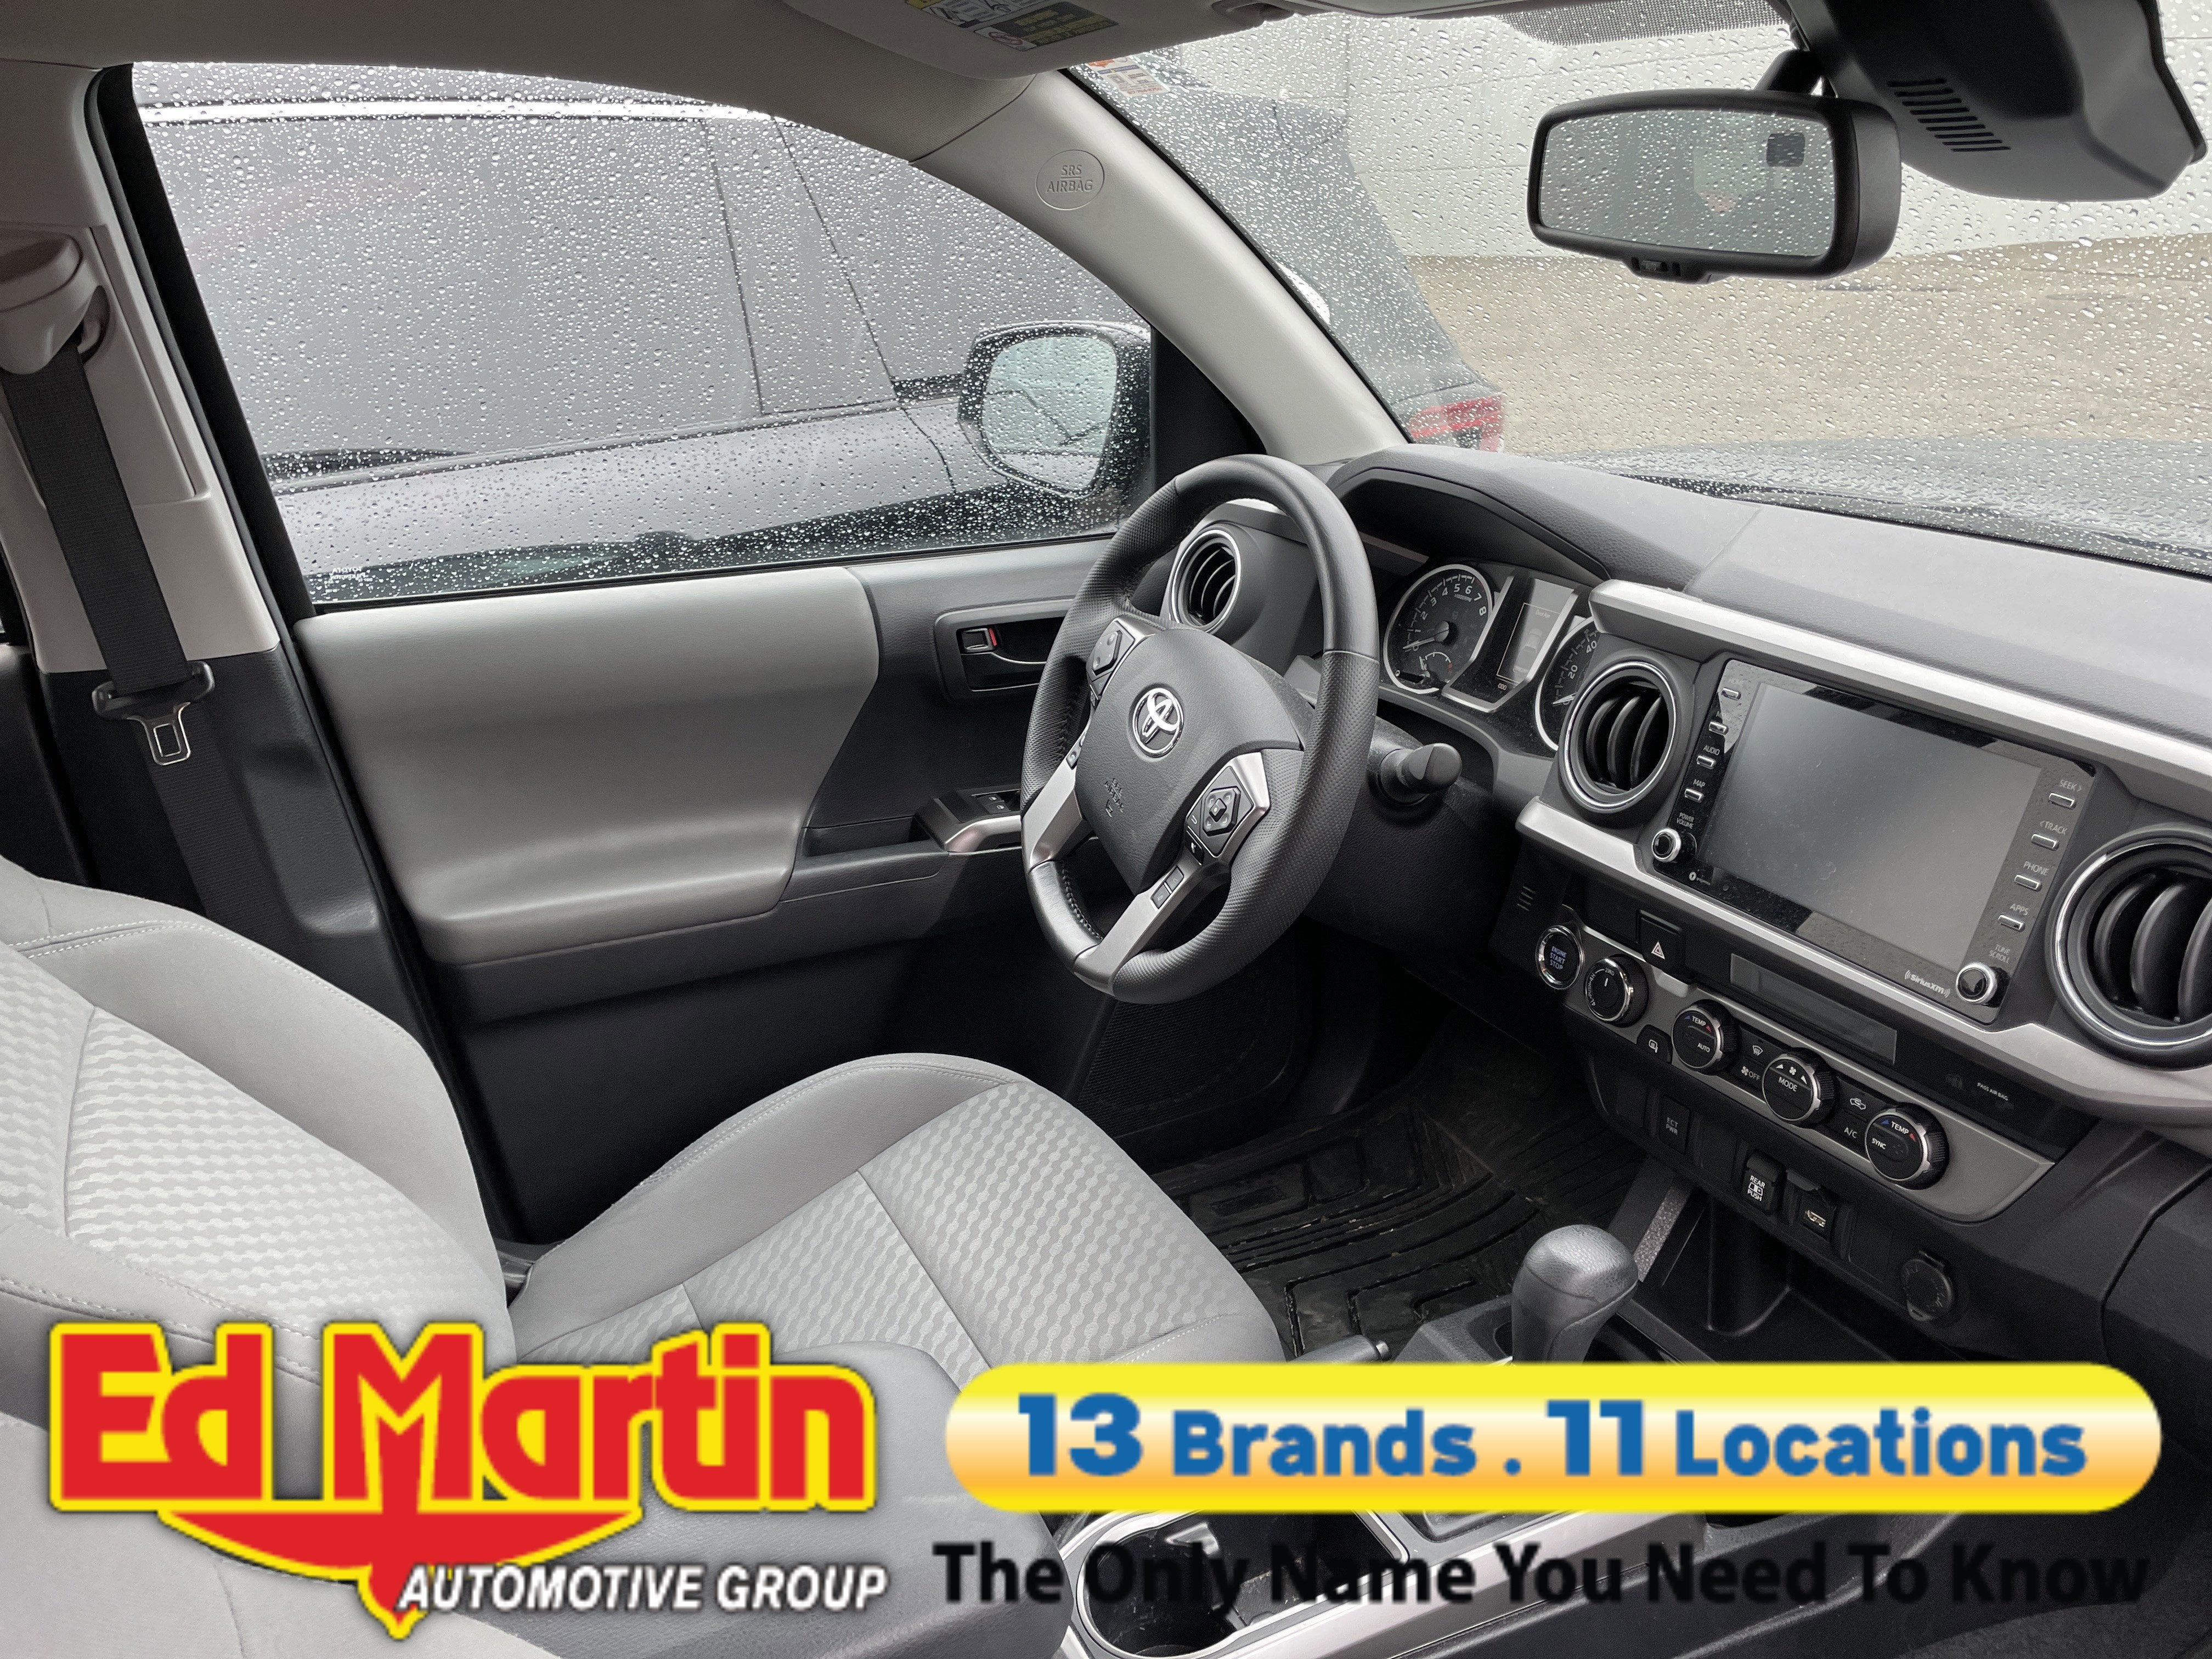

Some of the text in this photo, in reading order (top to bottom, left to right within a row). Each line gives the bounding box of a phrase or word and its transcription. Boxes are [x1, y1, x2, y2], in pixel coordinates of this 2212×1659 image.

[1061, 165, 1082, 176] SRS
[1046, 180, 1093, 193] AIRBAG
[1442, 587, 1448, 596] 4
[1454, 583, 1461, 592] 5
[1465, 585, 1473, 594] 6
[1430, 597, 1437, 607] 3
[1474, 592, 1482, 601] 7
[1420, 611, 1427, 620] 2
[1479, 606, 1487, 616] 8
[1586, 640, 1598, 653] 40
[1567, 664, 1578, 679] 20
[1703, 745, 1720, 756] AUDIO
[1693, 779, 1706, 788] MAP
[2059, 779, 2076, 791] SEEK
[1679, 812, 1694, 822] POWER
[1677, 818, 1694, 829] VOLUME
[2045, 821, 2068, 835] TRACK
[2023, 861, 2049, 876] PHONE
[2010, 903, 2029, 916] APPS
[1551, 946, 1567, 957] ENGINE
[1995, 944, 2011, 956] TUNE
[1550, 952, 1565, 964] START
[1989, 950, 2010, 964] SCROLL
[1550, 960, 1563, 970] STOP
[1692, 1015, 1706, 1026] TEMP
[1697, 1042, 1710, 1053] AUTO
[1748, 1071, 1760, 1081] OFF
[1778, 1076, 1798, 1092] MODE
[1667, 1116, 1678, 1128] ECT
[1666, 1124, 1678, 1135] PWR
[1843, 1127, 1858, 1139] A/C
[1892, 1121, 1909, 1135] TEMP
[1871, 1137, 1887, 1150] SYNC
[1750, 1175, 1765, 1189] REAR
[1747, 1189, 1762, 1201] PUSH
